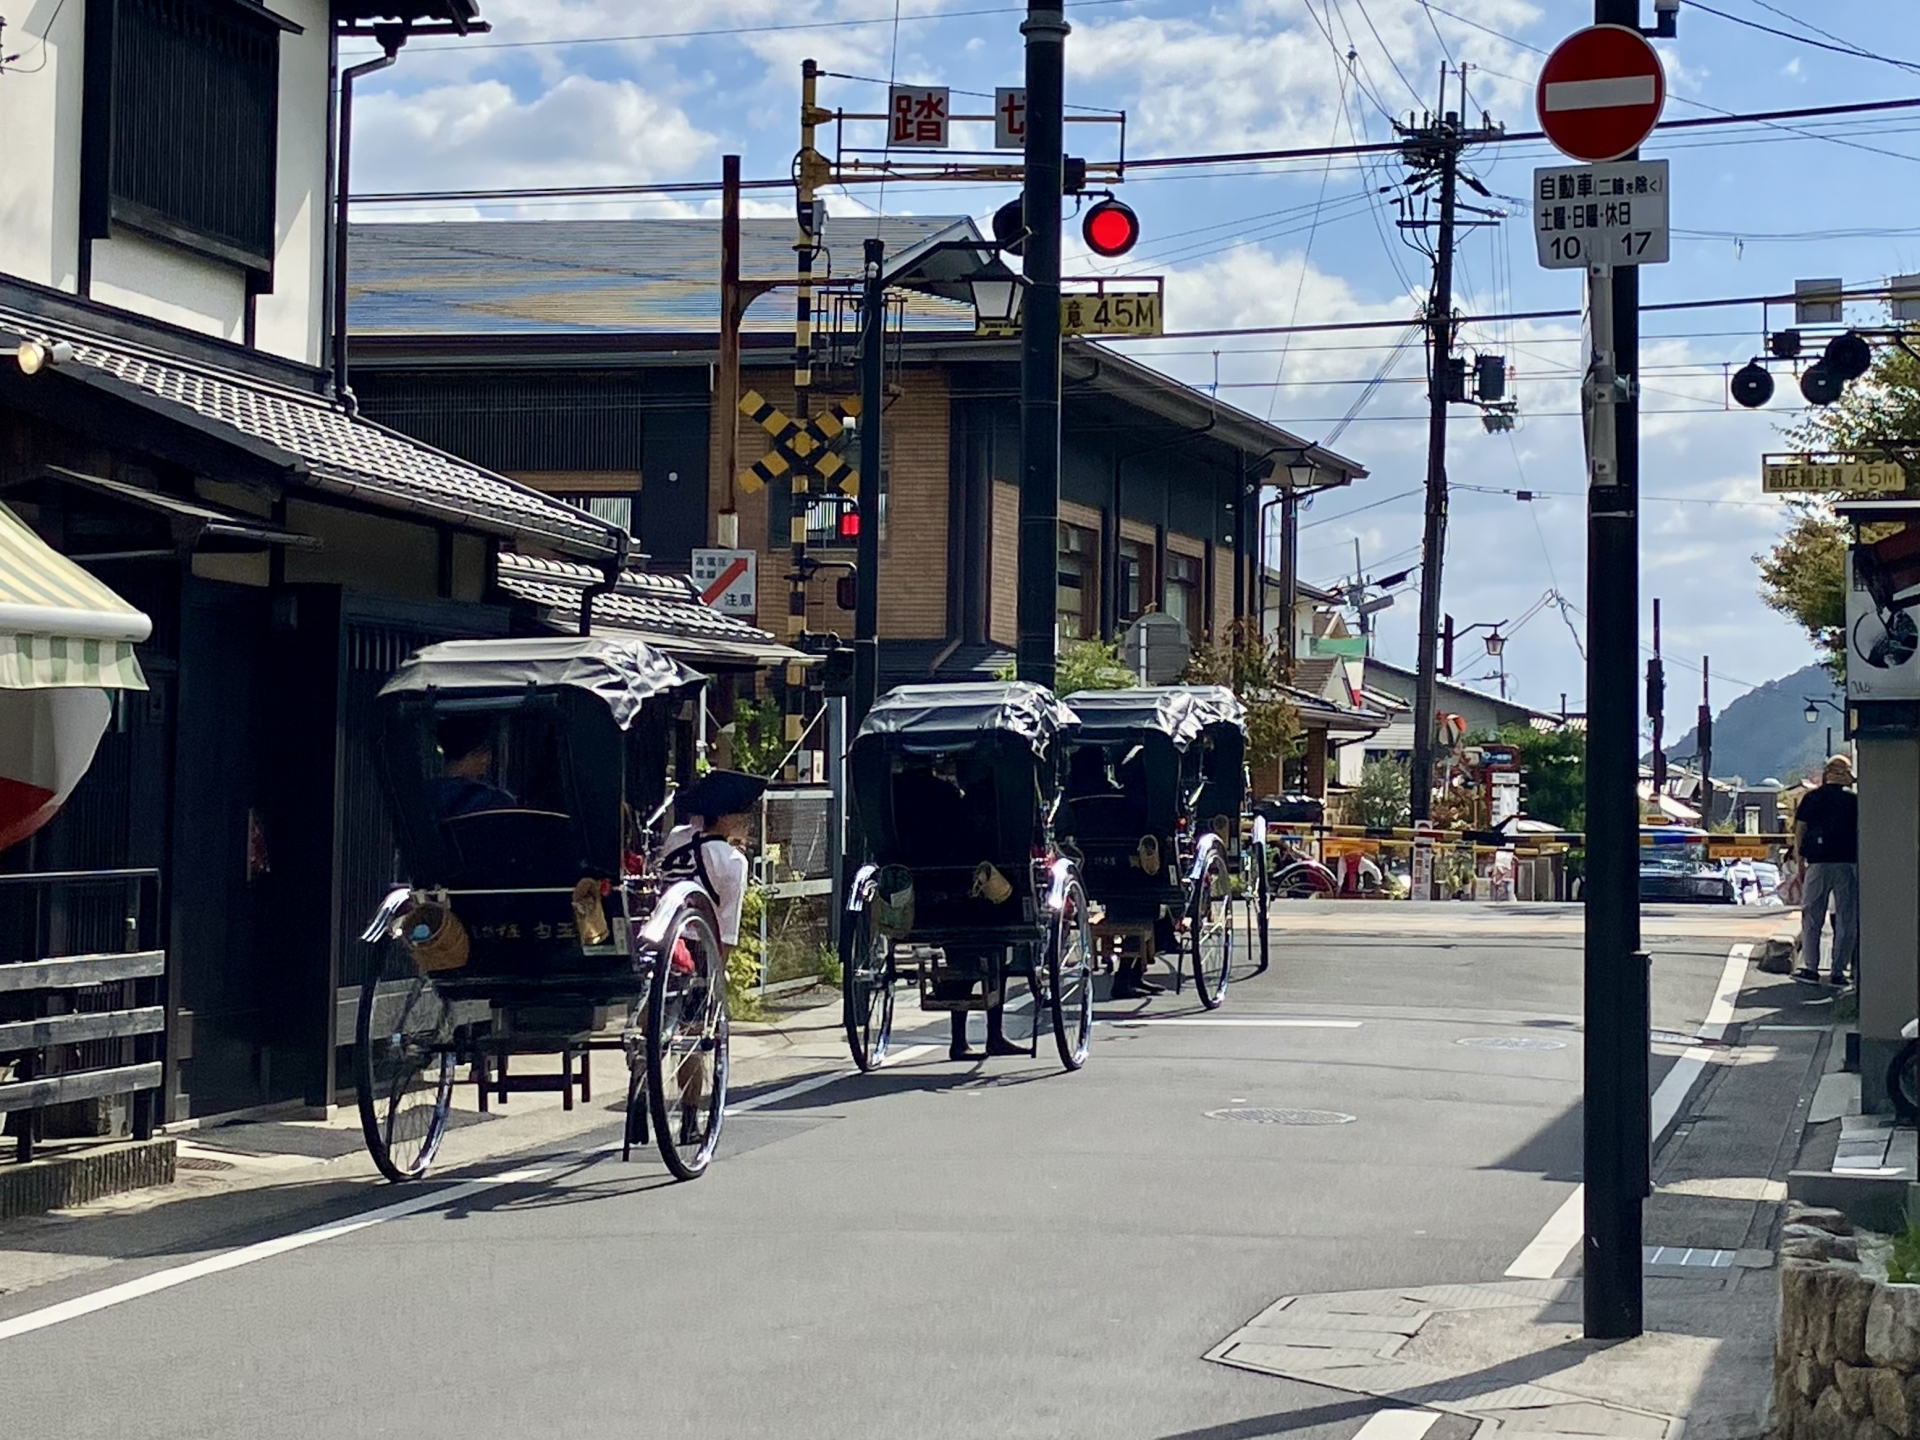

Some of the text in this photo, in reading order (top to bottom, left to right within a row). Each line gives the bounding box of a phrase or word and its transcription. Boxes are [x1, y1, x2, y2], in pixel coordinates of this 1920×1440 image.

[893, 92, 945, 142] 踏
[1550, 231, 1652, 260] 10 17
[1094, 299, 1154, 328] 45M
[724, 593, 752, 607] 注意
